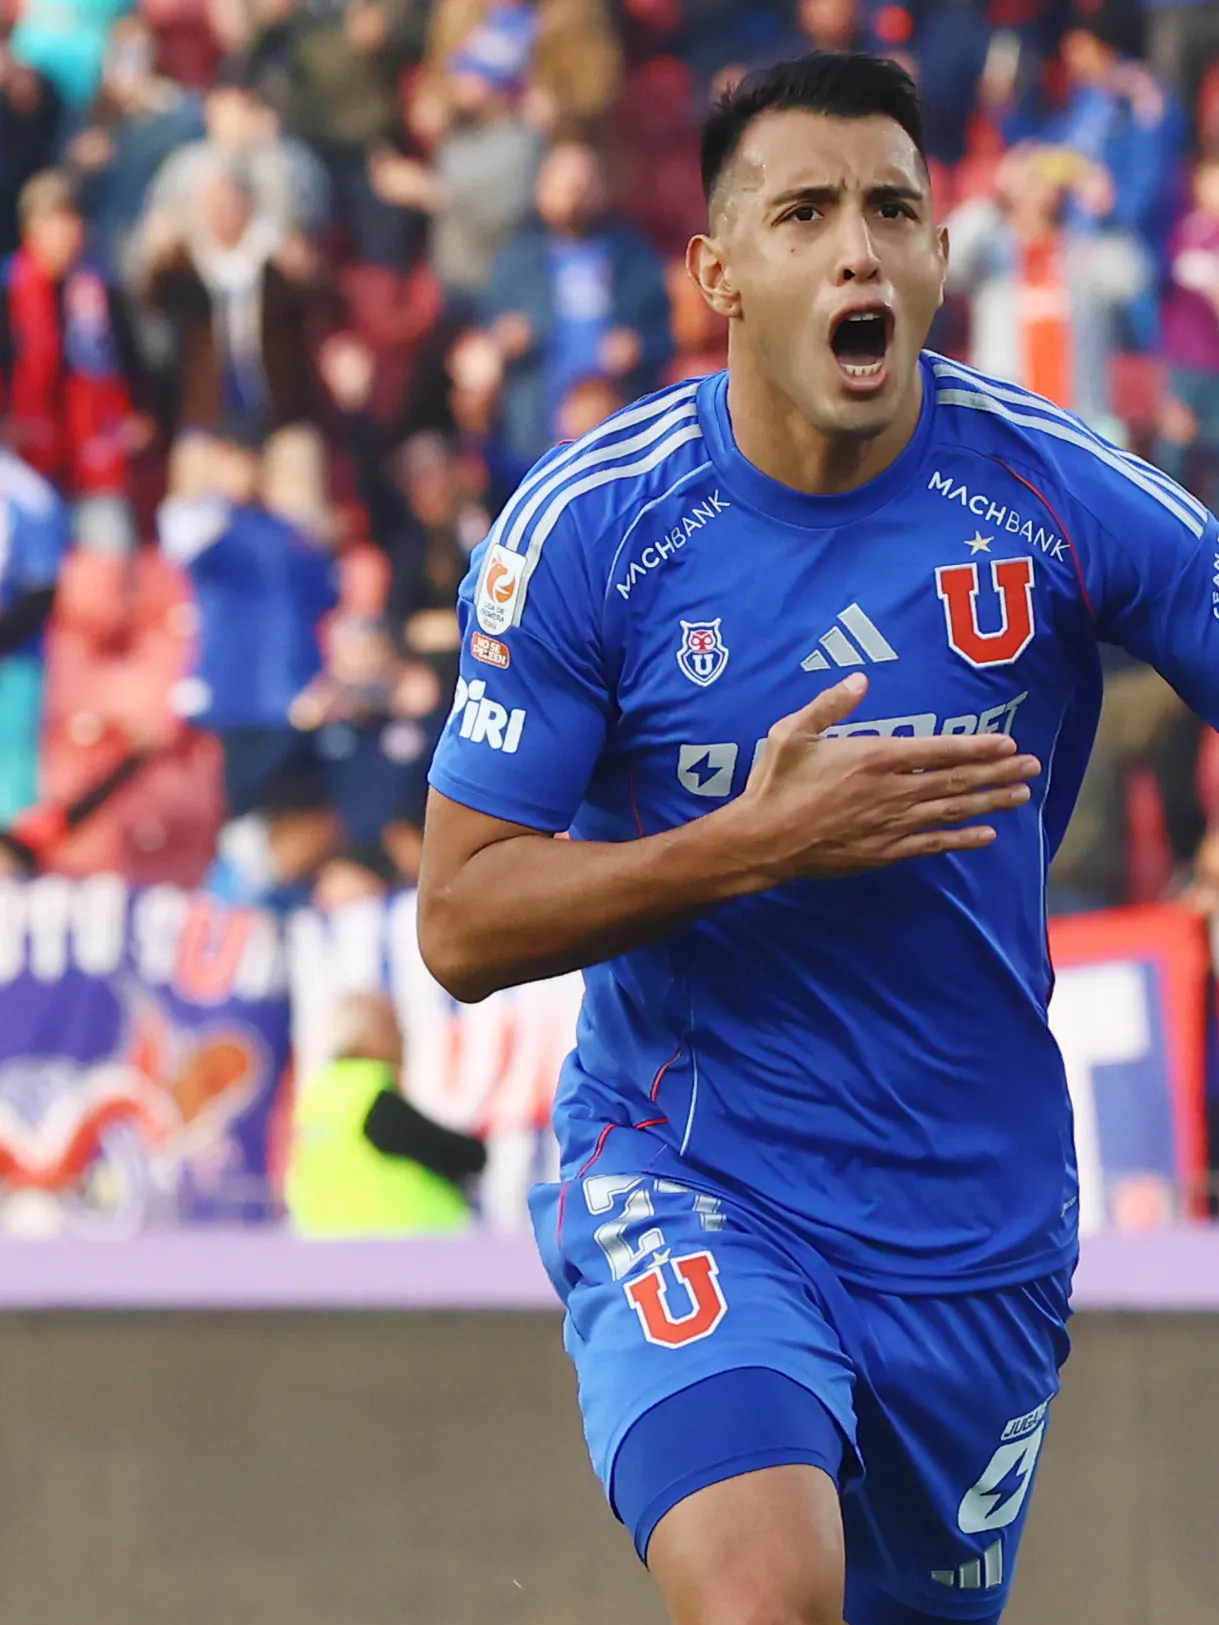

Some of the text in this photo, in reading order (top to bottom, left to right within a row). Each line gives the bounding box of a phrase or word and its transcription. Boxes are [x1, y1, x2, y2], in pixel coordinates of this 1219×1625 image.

[616, 489, 731, 600] MACHBANK
[928, 471, 1071, 562] MACHBANK
[934, 556, 1035, 669] U
[692, 653, 715, 675] U
[623, 1250, 728, 1349] U
